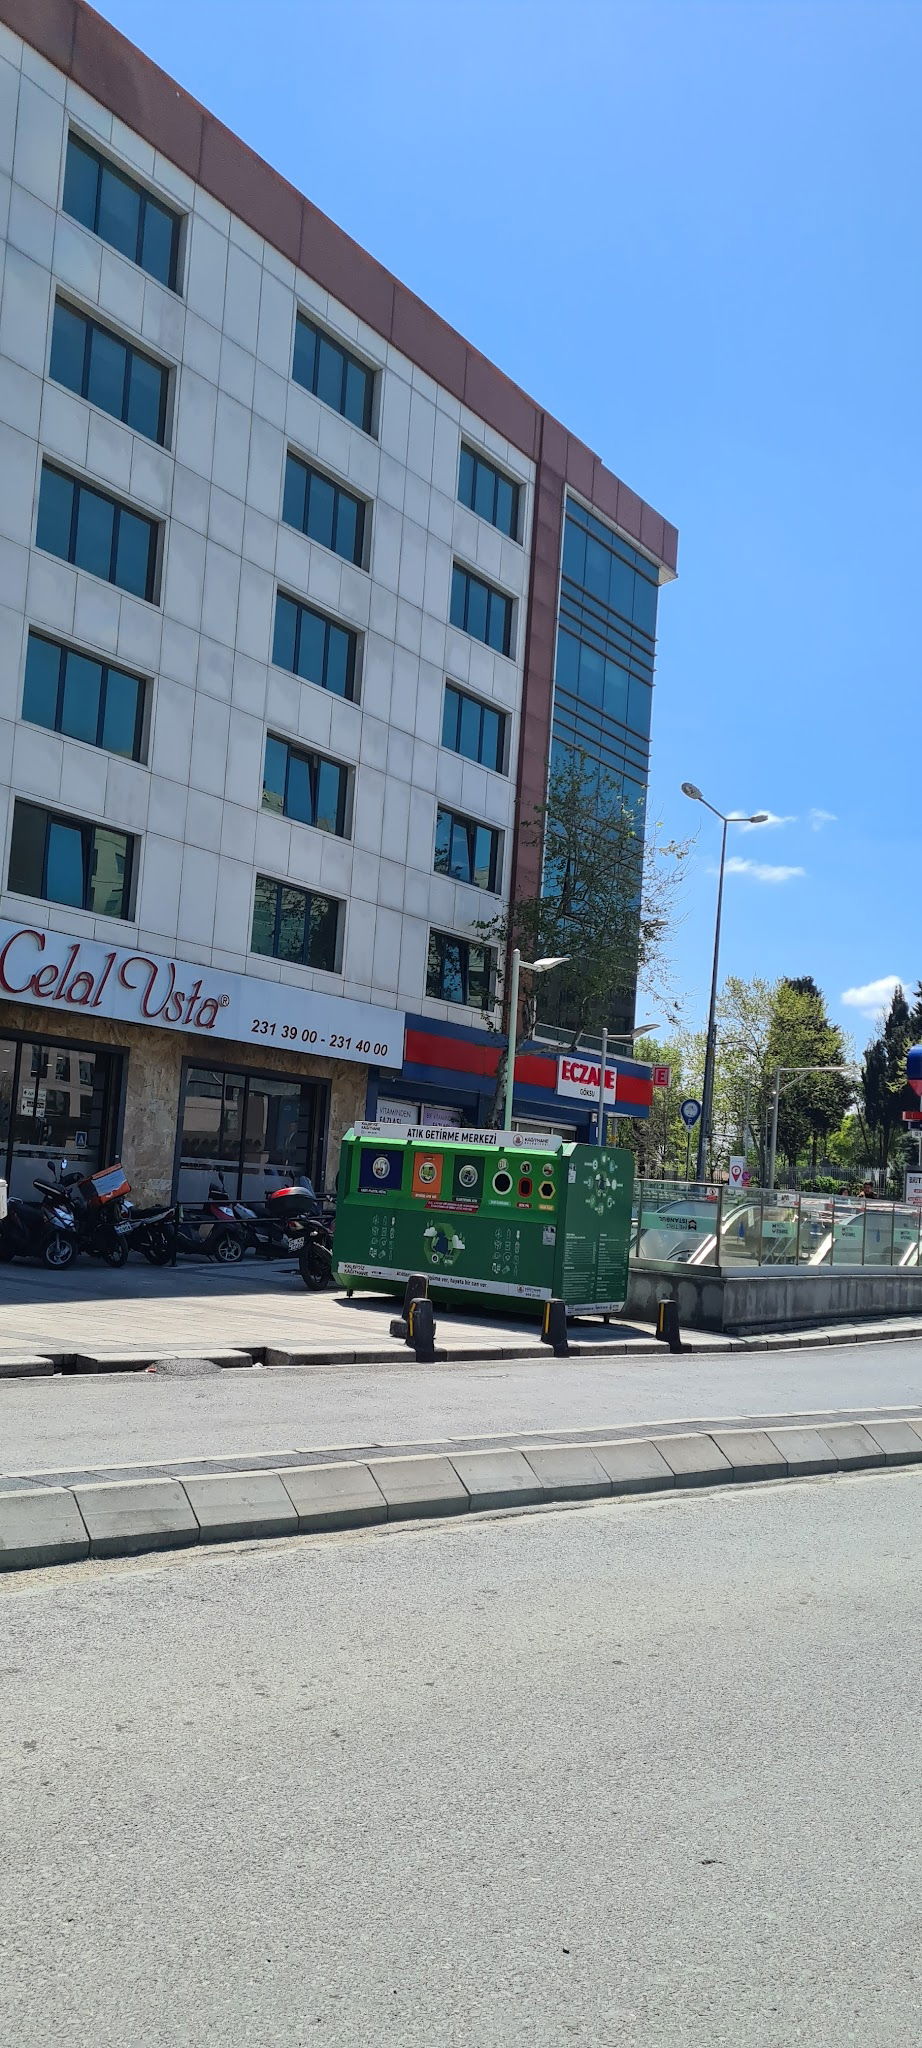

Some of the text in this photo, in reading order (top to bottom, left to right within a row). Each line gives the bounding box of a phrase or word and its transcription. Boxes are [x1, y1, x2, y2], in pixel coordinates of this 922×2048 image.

[0, 929, 116, 1007] Celal
[251, 1019, 276, 1036] 231
[281, 1025, 298, 1040] 39
[301, 1029, 318, 1044] 00
[329, 1034, 352, 1050] 231
[355, 1039, 371, 1053] 40
[373, 1042, 388, 1057] 00
[657, 1069, 666, 1083] E
[406, 1128, 497, 1145] ATIK GETİRME MERKEZİ
